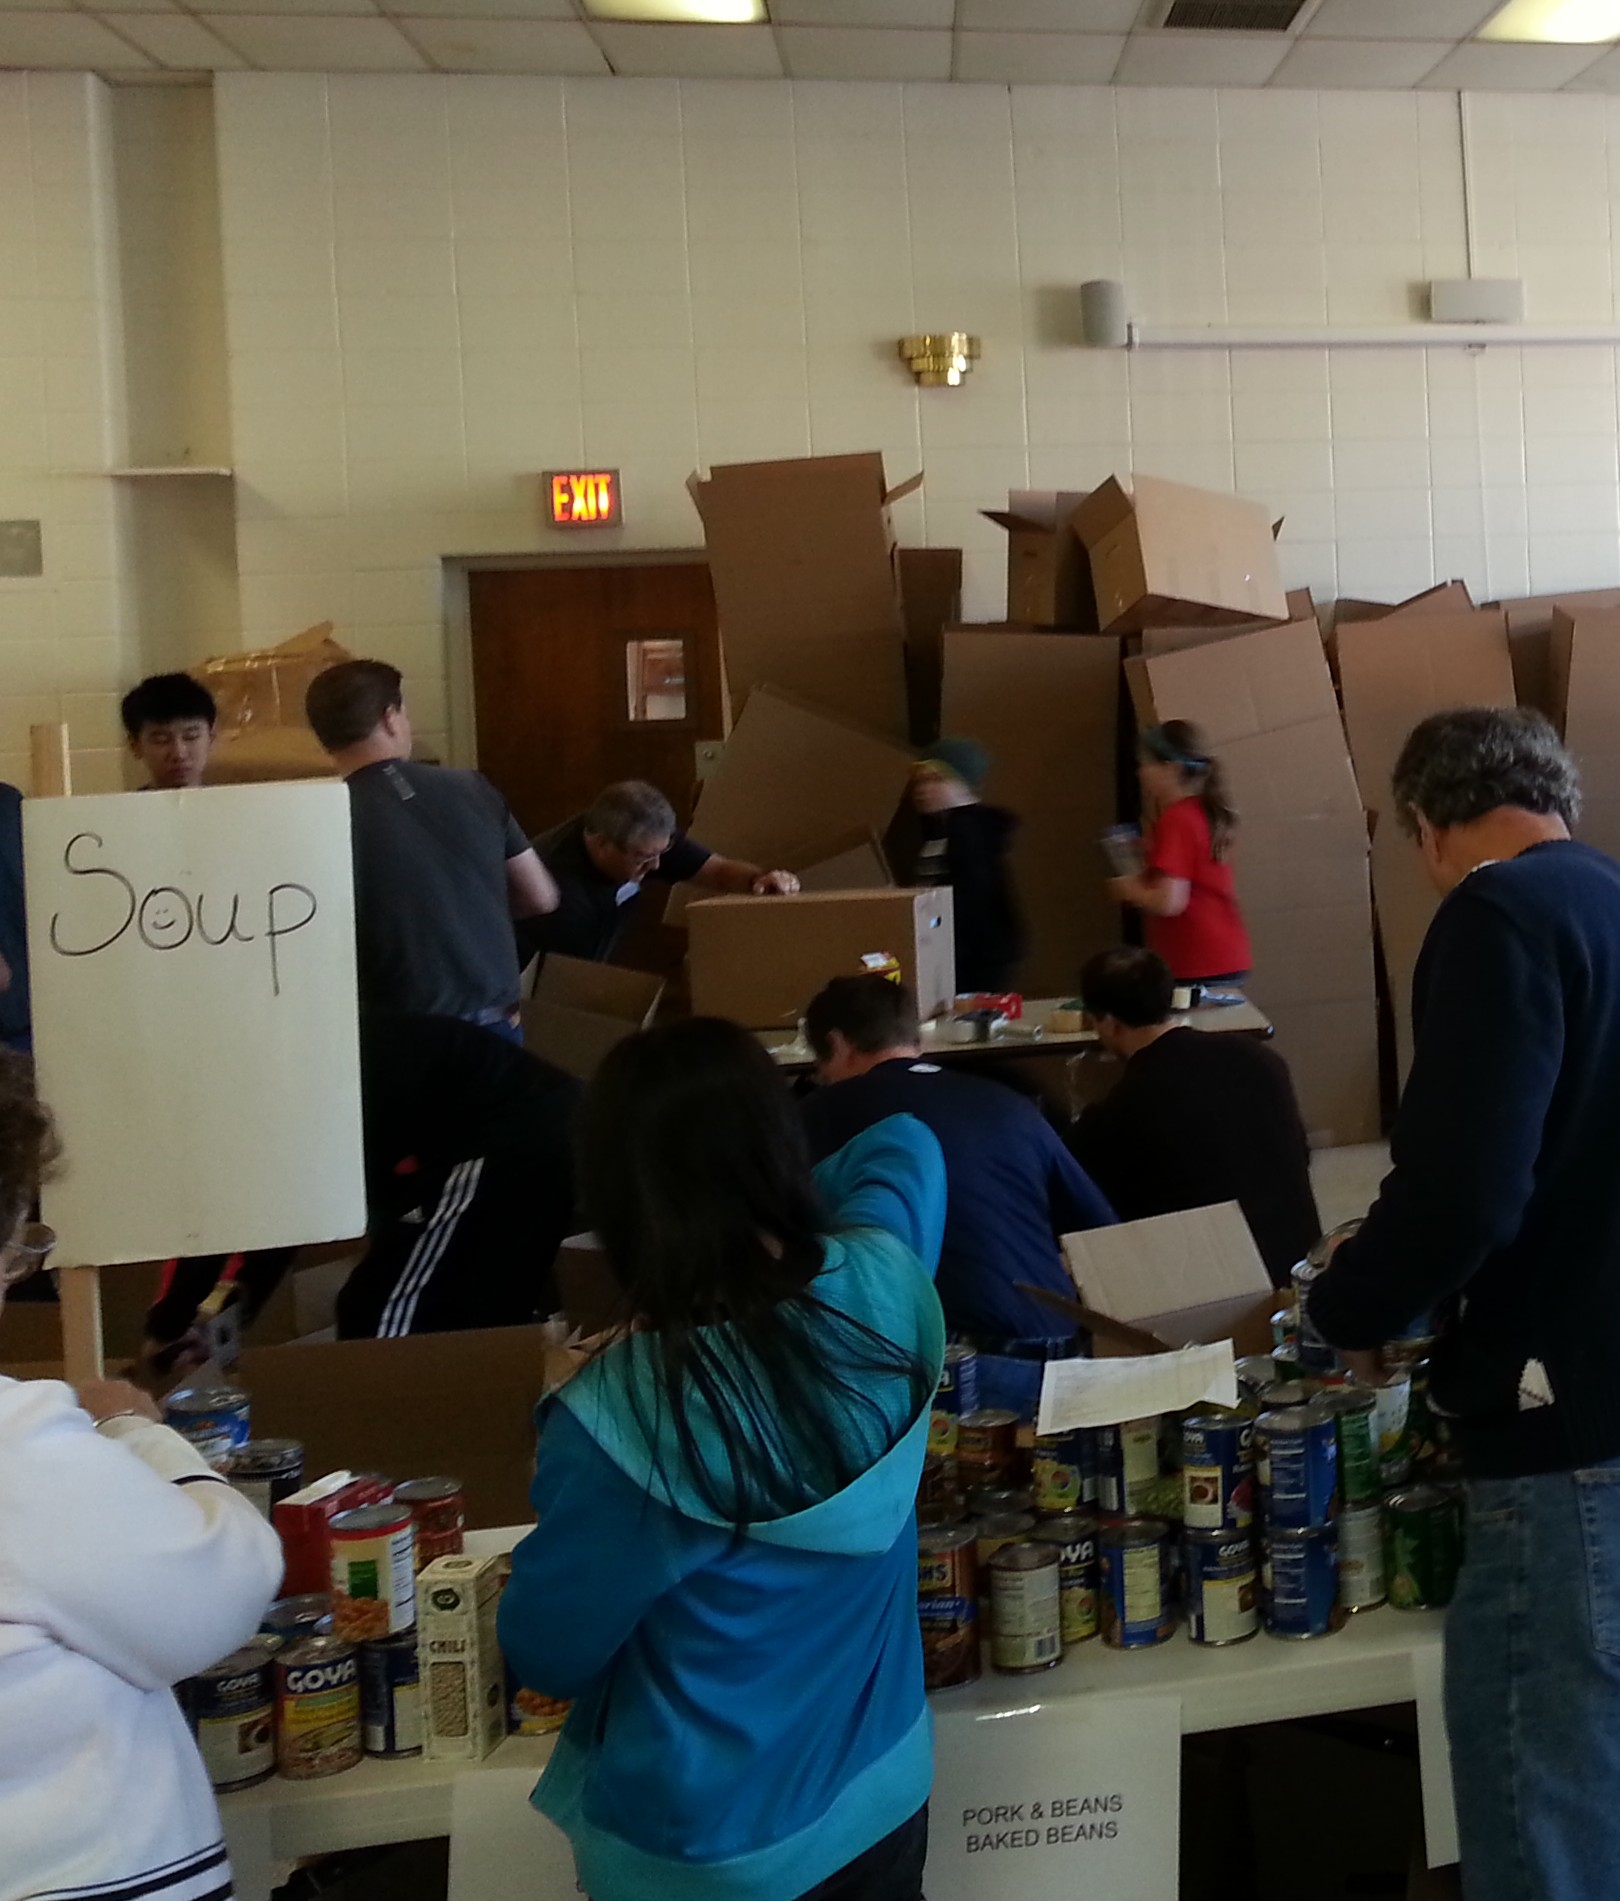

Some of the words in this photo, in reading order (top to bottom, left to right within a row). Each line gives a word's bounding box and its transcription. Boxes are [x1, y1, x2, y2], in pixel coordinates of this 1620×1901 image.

[552, 473, 611, 521] EXIT
[49, 832, 318, 997] Soup
[286, 1657, 358, 1693] GOYA
[962, 1804, 1025, 1828] PORK
[1029, 1801, 1045, 1820] &
[1050, 1793, 1124, 1819] BEANS
[965, 1828, 1041, 1855] BAKED
[1045, 1820, 1119, 1846] BEANS
